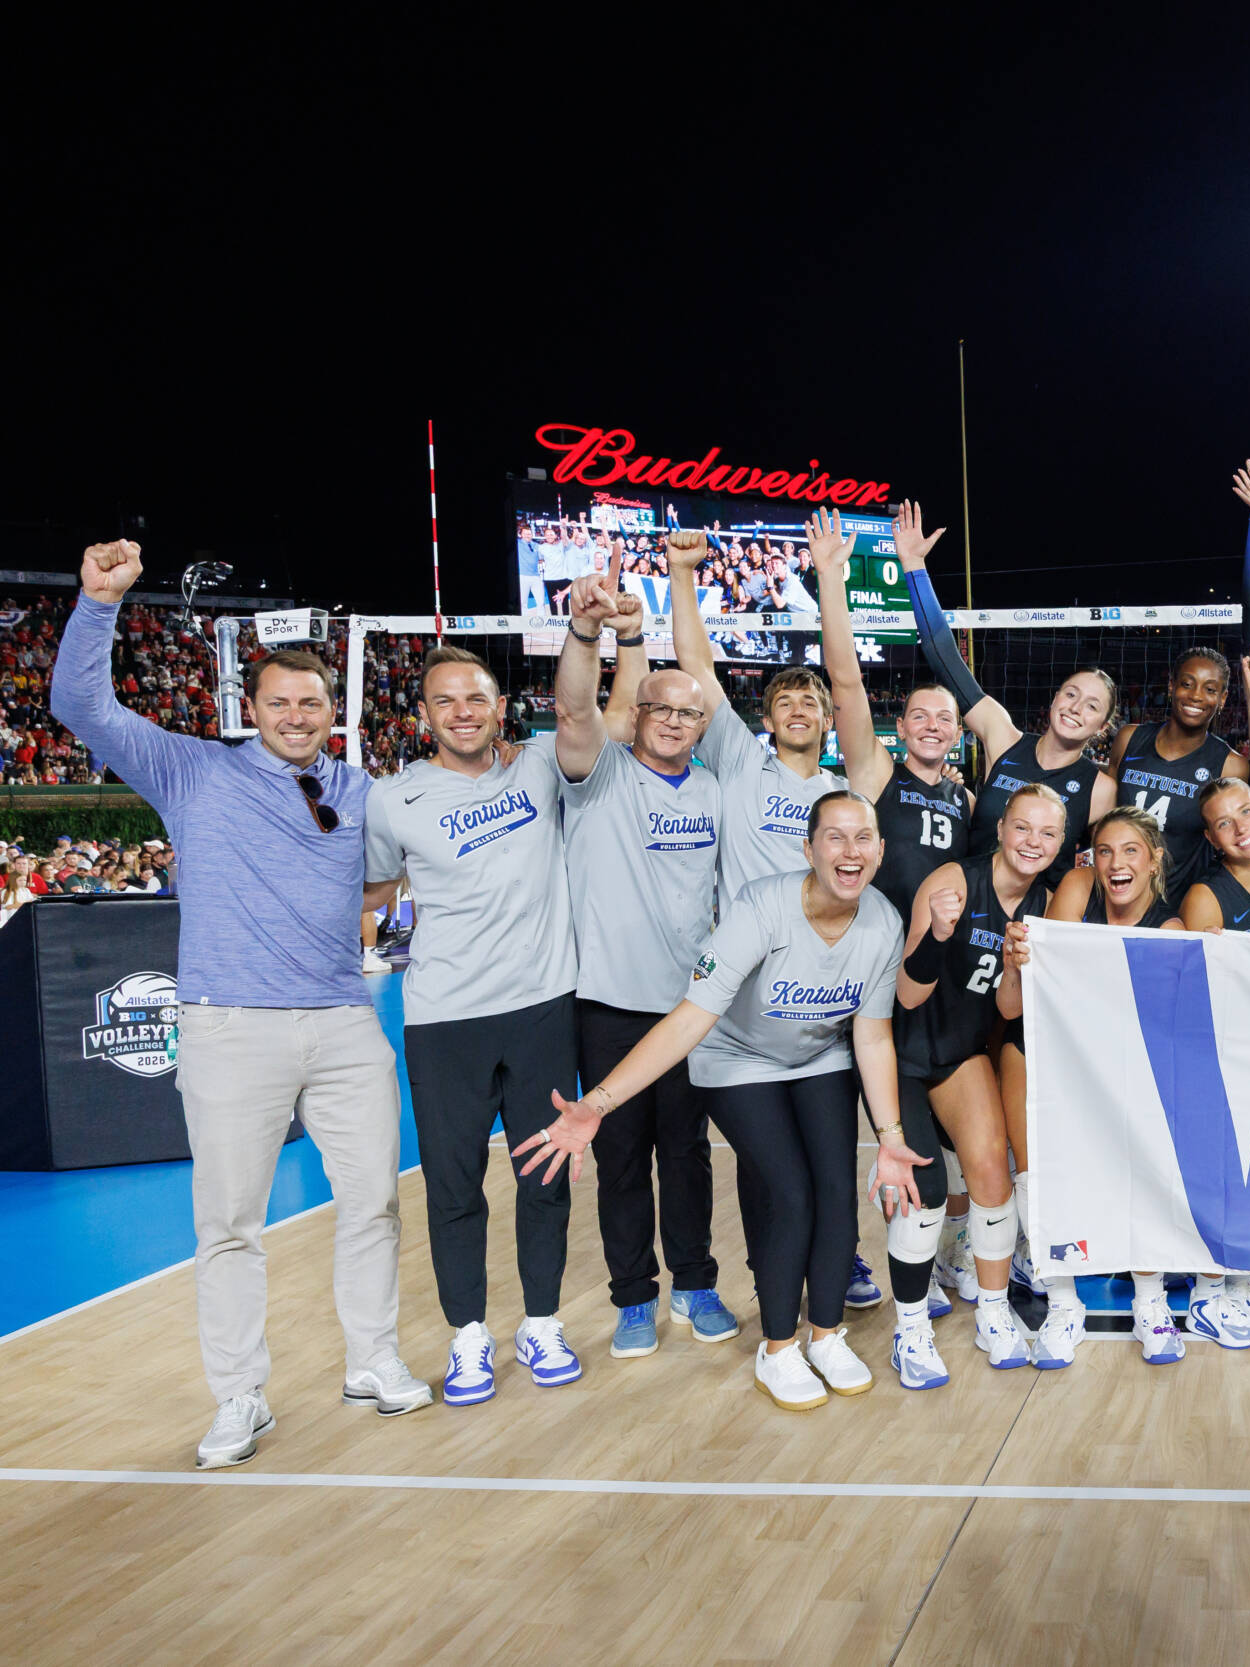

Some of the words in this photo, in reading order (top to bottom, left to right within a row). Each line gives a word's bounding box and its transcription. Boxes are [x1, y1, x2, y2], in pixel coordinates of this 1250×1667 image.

[535, 423, 891, 506] Budweiser
[883, 561, 898, 585] 0
[850, 591, 885, 605] FINAL
[866, 614, 900, 625] Allstate
[1030, 611, 1065, 621] Allstate
[1197, 608, 1233, 618] Allstate
[271, 618, 288, 626] DV
[545, 618, 570, 628] Allsta
[704, 616, 738, 626] Allstate
[1121, 768, 1199, 800] KENTUCKY
[899, 789, 962, 820] KENTUCKY
[1135, 790, 1171, 832] 14
[439, 789, 533, 841] Kentucky
[648, 811, 716, 837] Kentucky
[920, 810, 953, 850] 13
[468, 826, 511, 850] VOLLEYBALL
[659, 843, 696, 851] VOLLEYBALL
[769, 977, 865, 1007] Kentucky
[125, 996, 170, 1006] Allstate
[781, 1011, 826, 1020] VOLLEYBALL
[108, 1041, 164, 1056] CHALLENGE
[137, 1056, 166, 1066] 2026
